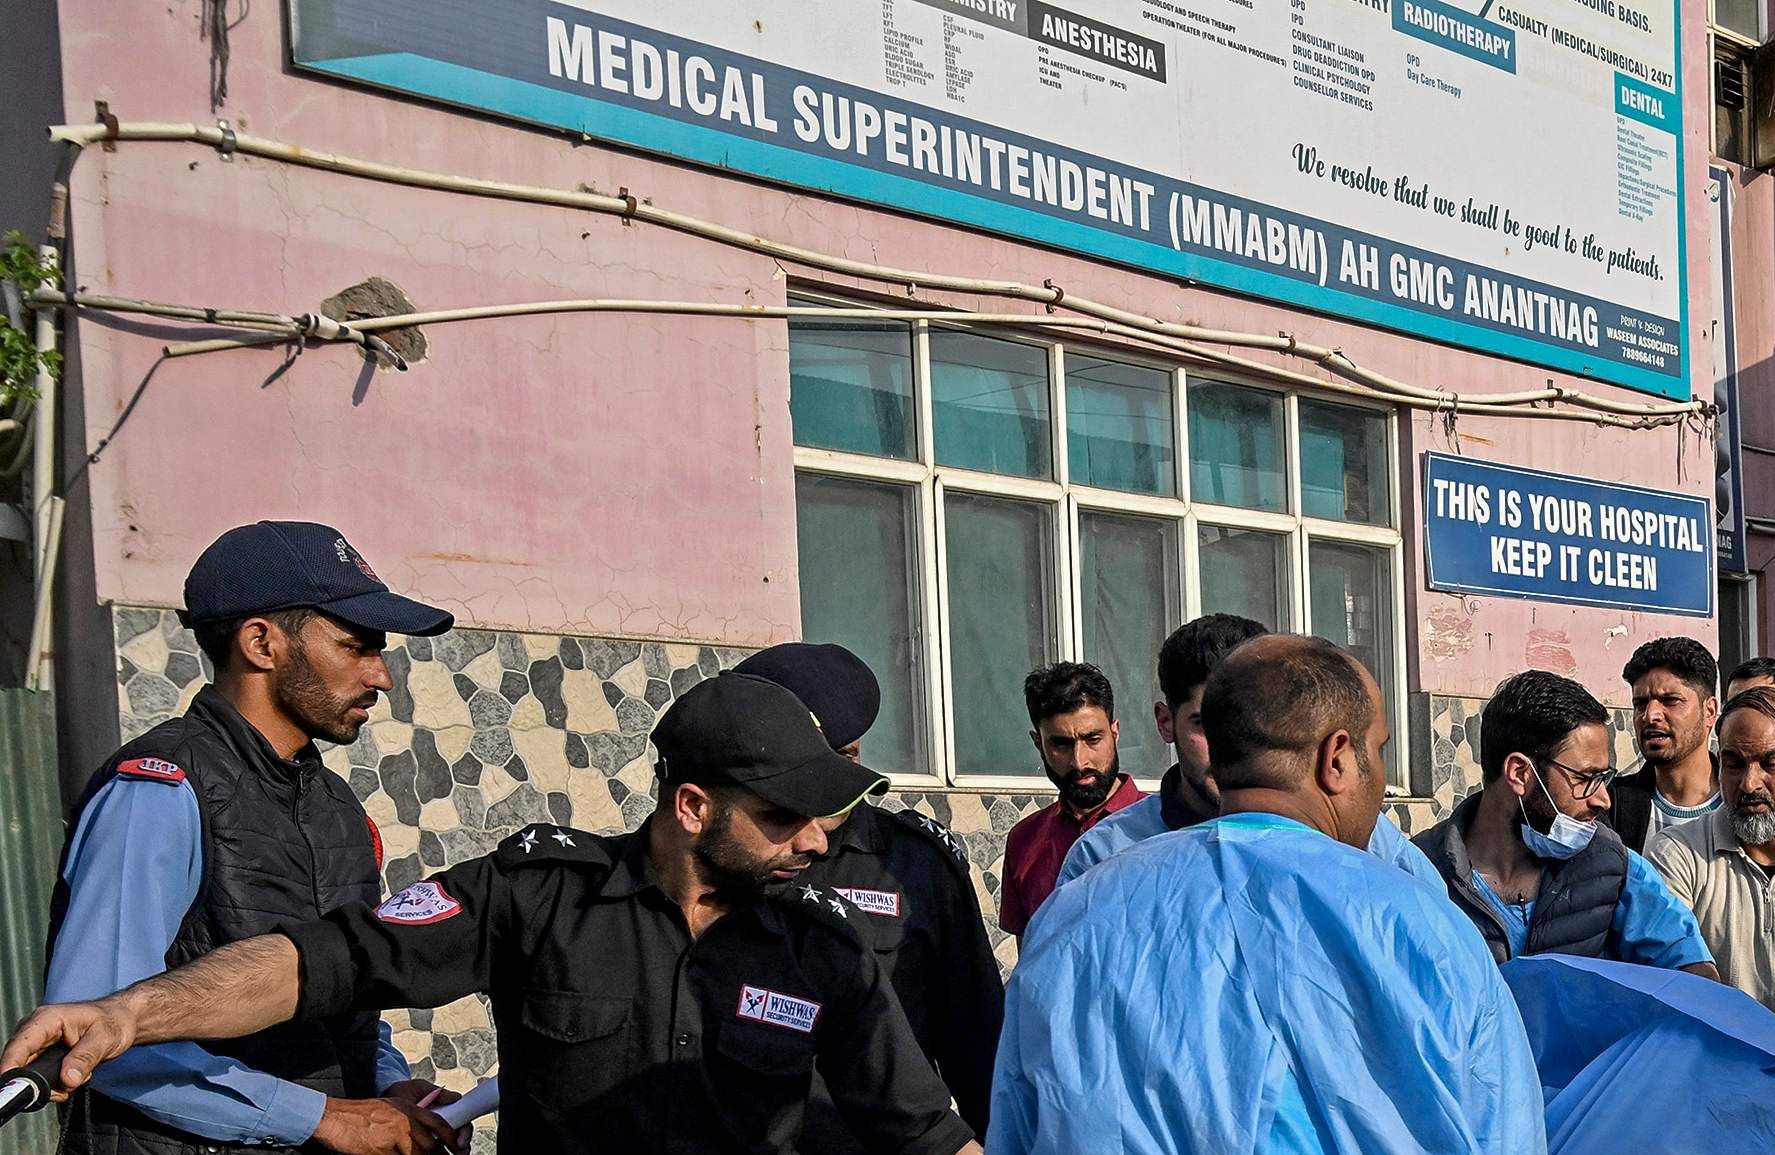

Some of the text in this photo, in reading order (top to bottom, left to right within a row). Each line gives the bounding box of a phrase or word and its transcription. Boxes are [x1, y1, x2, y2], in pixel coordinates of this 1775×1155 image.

[1142, 11, 1175, 28] OPERATION
[1176, 22, 1200, 37] THEATER
[1202, 32, 1215, 42] (FOR
[1217, 37, 1226, 46] ALL
[1228, 40, 1247, 53] MAJOR
[1174, 6, 1186, 16] AND
[1188, 10, 1210, 24] SPEECH
[1211, 18, 1236, 34] THERAPY
[1291, 13, 1303, 25] IPD
[1404, 1, 1510, 59] RADIOTHERAPY
[1618, 5, 1652, 33] BASIS.
[883, 28, 923, 46] LIPID PROFILE
[884, 36, 910, 49] CALCIUM
[884, 44, 913, 58] URIC ACID
[1042, 14, 1157, 73] ANESTHESIA
[1292, 29, 1364, 63] CONSULTANT LIAISON
[1499, 6, 1673, 88] CASUALTY (MEDICAL/SURGICAL) 24X7
[885, 52, 924, 69] BLOOD SUGAR
[1039, 56, 1049, 65] PRE
[1051, 61, 1080, 75] ANESTHESIA
[1082, 71, 1105, 83] CHECKUP
[1039, 67, 1060, 79] ICU AND
[1293, 45, 1375, 81] DRUG DEADDICTION OPD
[1407, 53, 1420, 67] OPD
[1040, 78, 1062, 90] THEATER
[1293, 60, 1370, 95] CLINICAL PSYCHOLOGY
[1407, 69, 1461, 99] Day Care Therapy
[1294, 76, 1373, 111] COUNSELLOR SERVICES
[1621, 85, 1665, 119] DENTAL
[545, 17, 1599, 348] MEDICAL SUPERINTENDENT (MMABM) AH GMC ANANTNAG
[1291, 142, 1664, 281] We resolve that we shall be good to the patients.
[1620, 315, 1637, 327] PRINT
[1606, 327, 1678, 356] WASEEM ASSOCIATES
[1433, 478, 1703, 553] THIS IS YOUR HOSPITAL
[1490, 536, 1657, 592] KEEP IT CLEEN
[854, 891, 895, 906] WISHWAS
[875, 904, 895, 913] SERVICES
[394, 910, 433, 918] SERVICES
[766, 1011, 790, 1025] SECURITY
[771, 996, 815, 1021] WISHWAS
